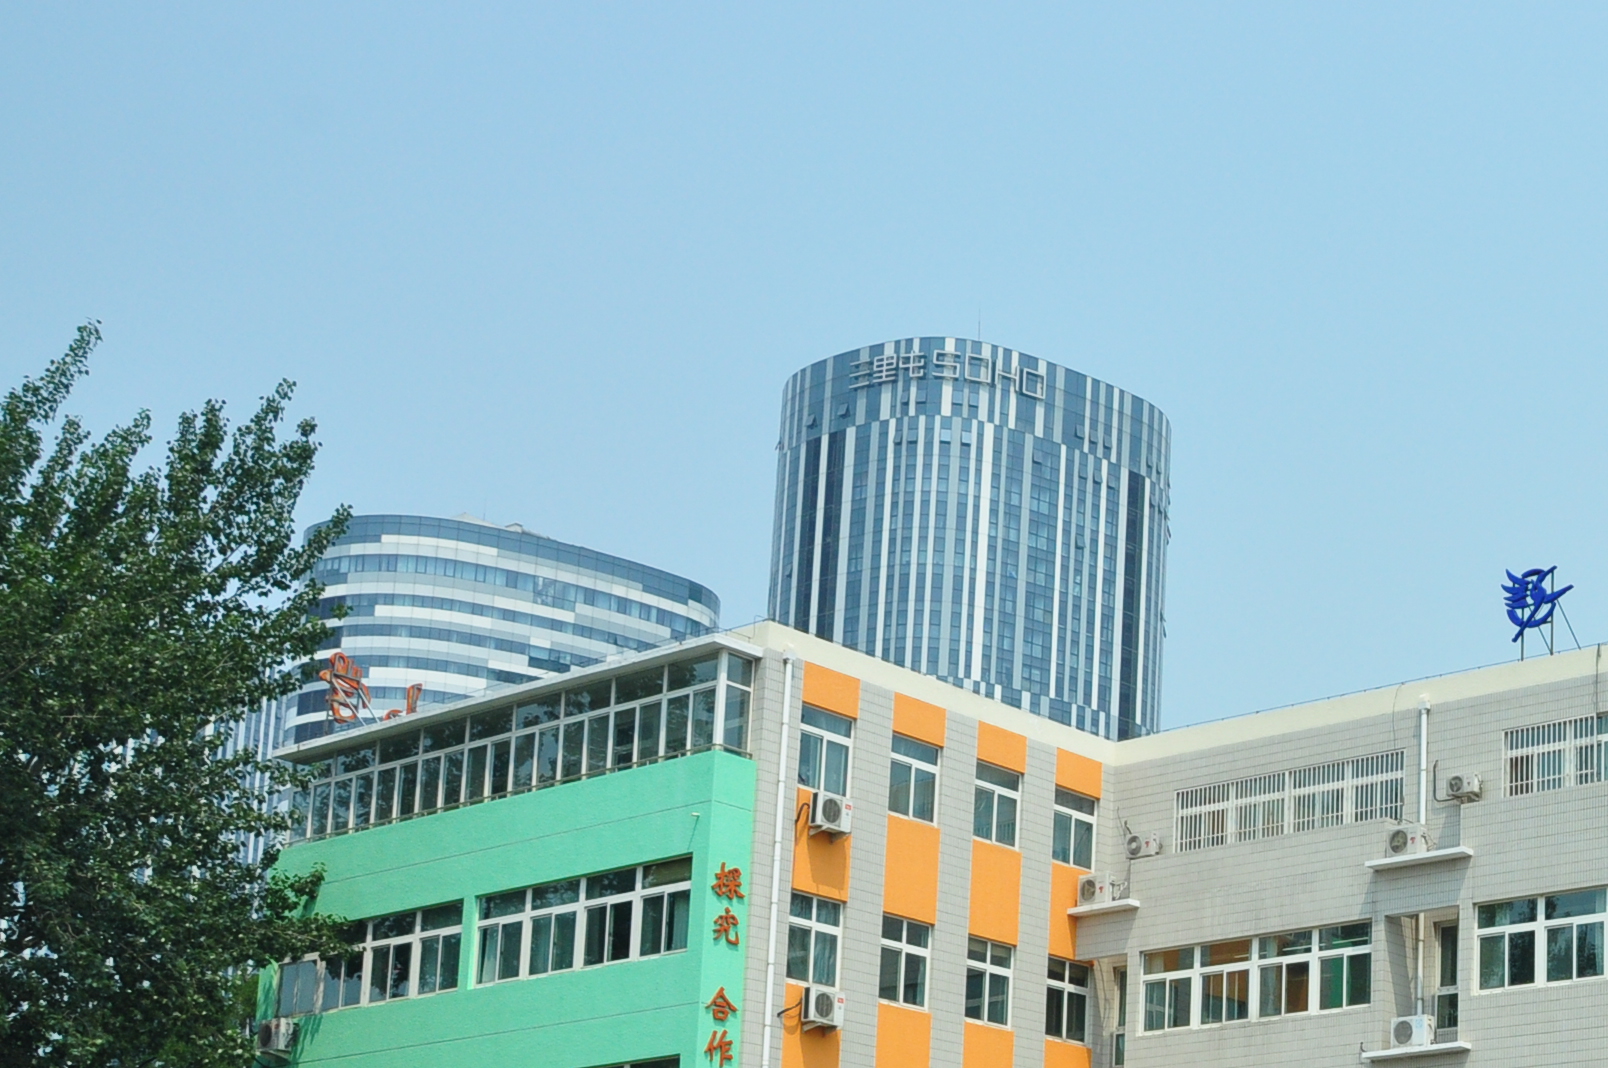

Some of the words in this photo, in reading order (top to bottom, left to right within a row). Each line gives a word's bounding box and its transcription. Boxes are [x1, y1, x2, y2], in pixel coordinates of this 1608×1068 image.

[849, 350, 925, 389] 三里屯
[932, 350, 1046, 400] SOHO
[710, 861, 746, 948] 探究
